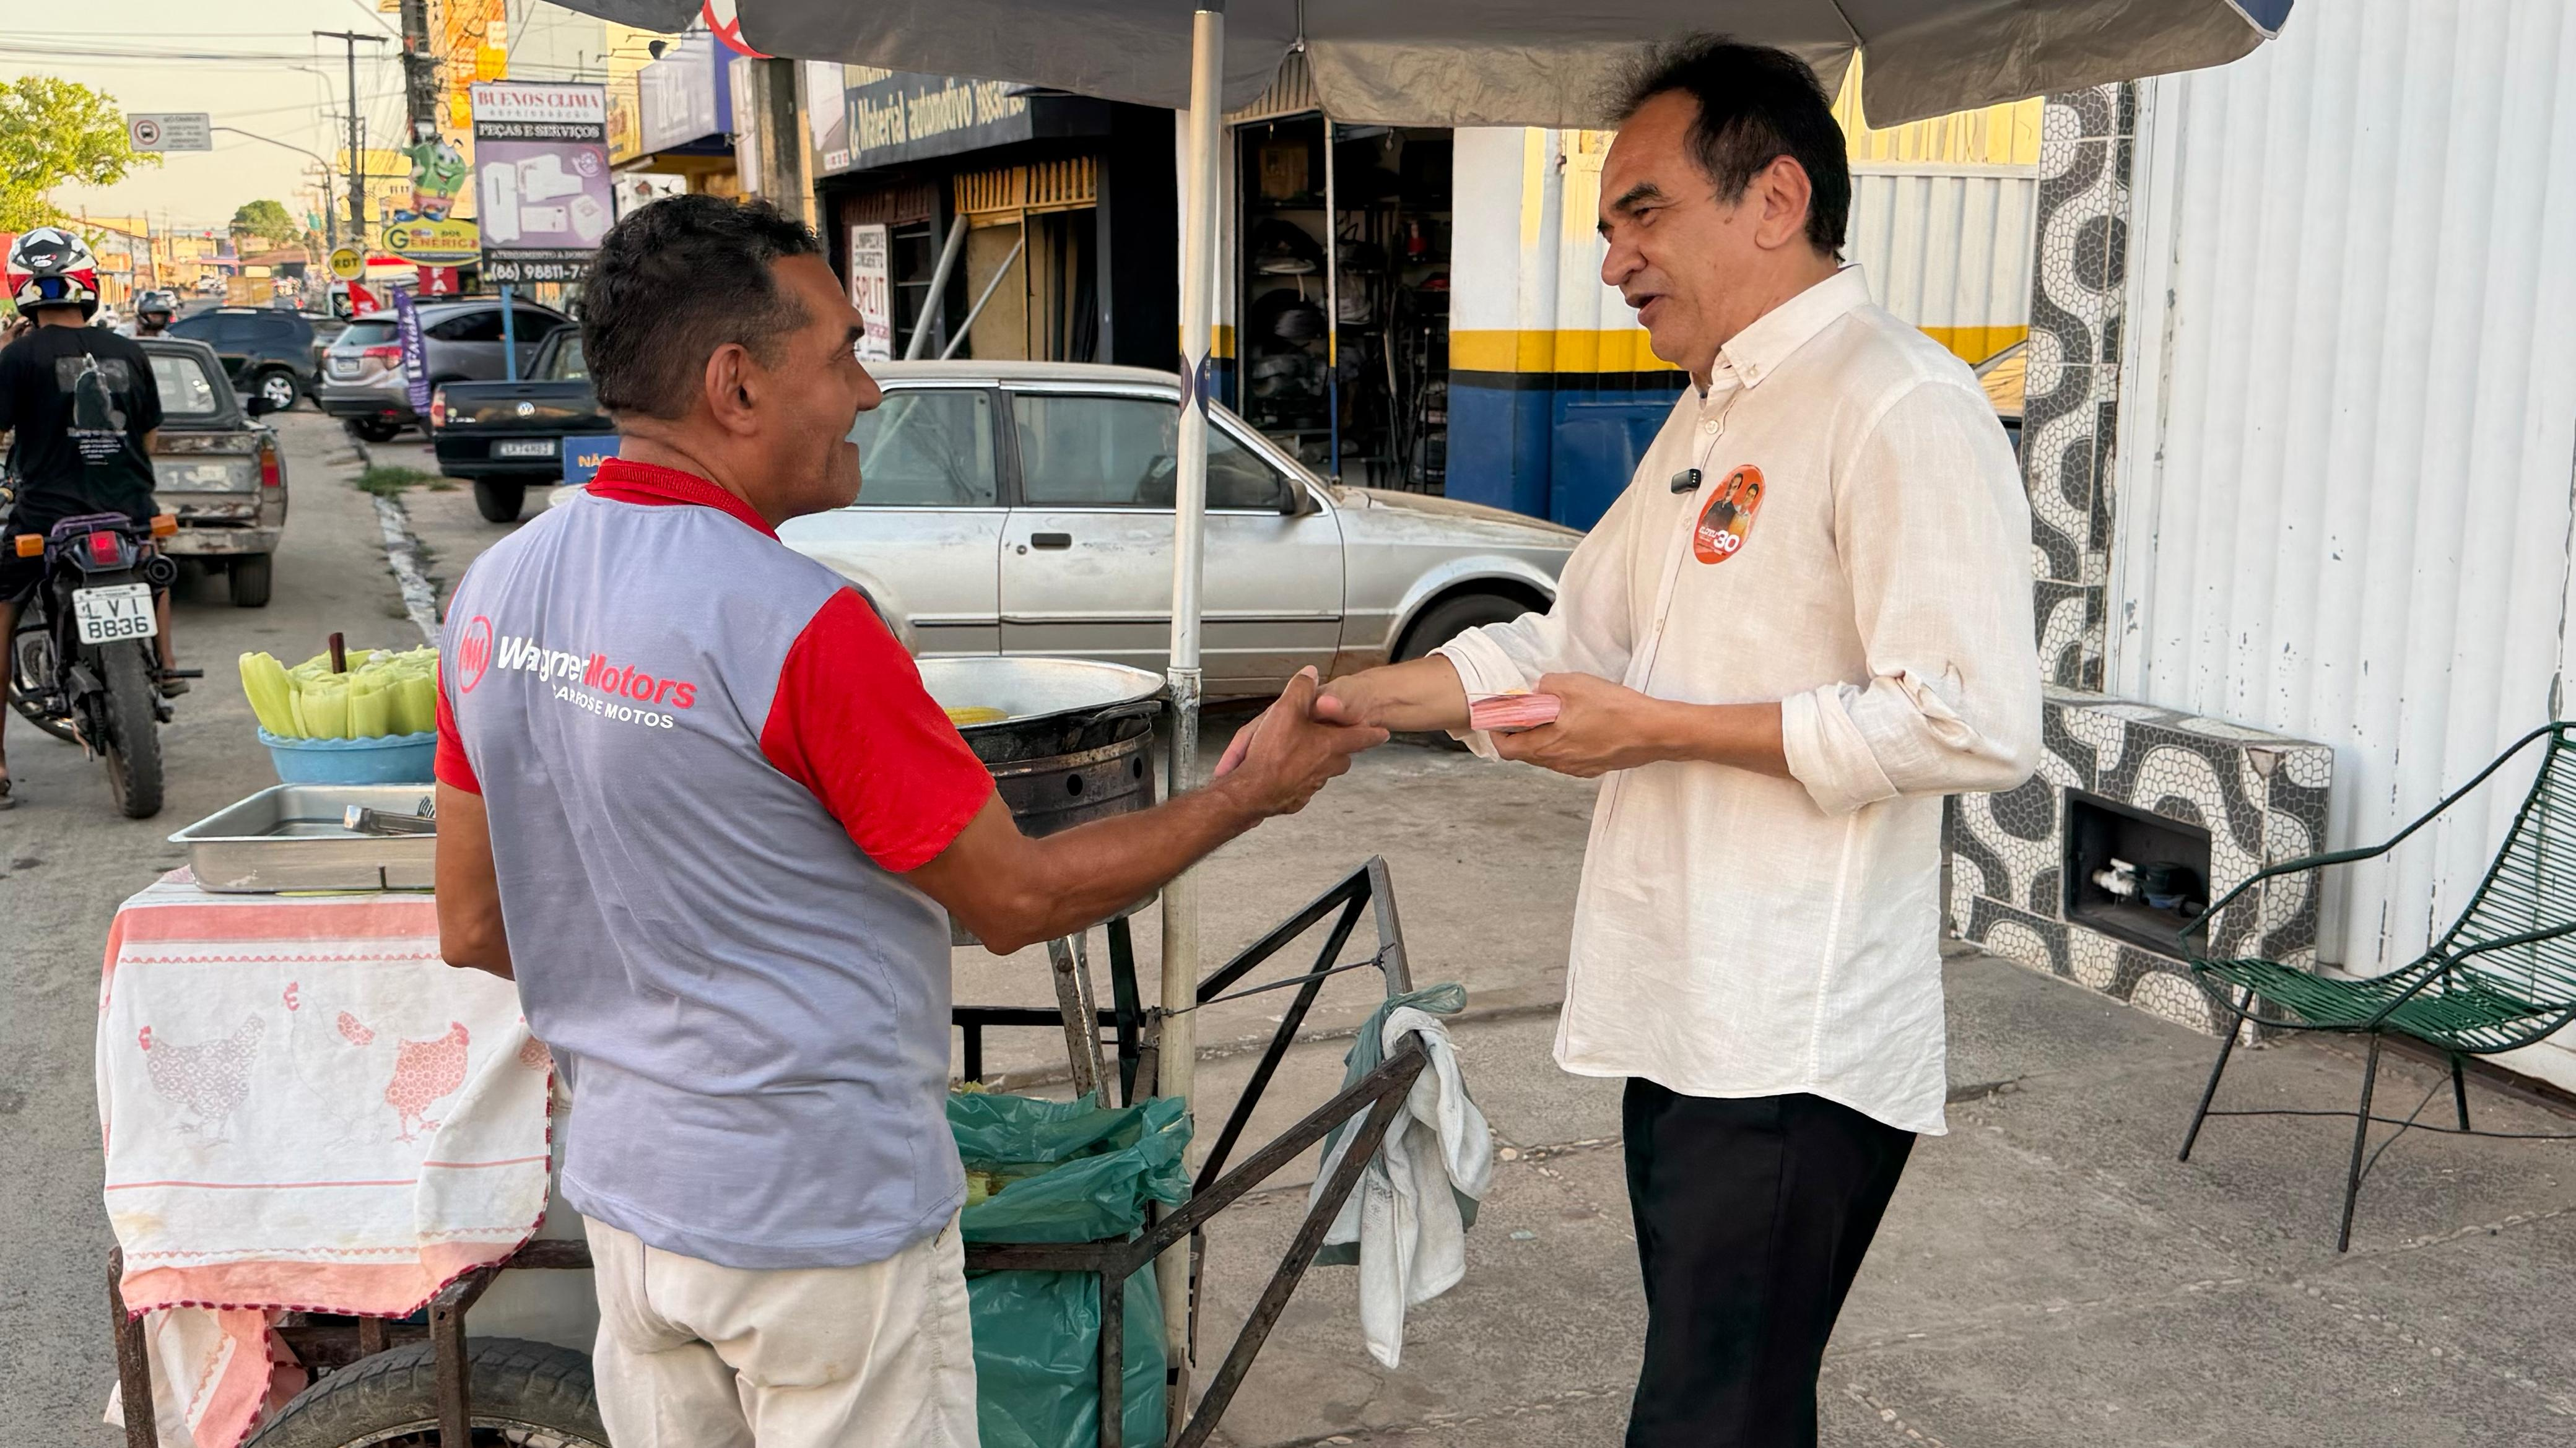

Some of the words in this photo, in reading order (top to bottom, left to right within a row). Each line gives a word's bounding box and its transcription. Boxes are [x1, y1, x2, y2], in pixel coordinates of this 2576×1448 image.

[477, 91, 543, 106] BUENOS
[547, 93, 599, 108] CLIMA
[479, 123, 522, 138] PEÇAS
[523, 124, 534, 137] E
[534, 124, 600, 140] SERVIÇOS
[858, 90, 907, 152] Material
[491, 261, 521, 282] (86)
[1713, 529, 1740, 553] 30
[87, 616, 149, 639] 8836
[604, 703, 674, 729] MOTOS
